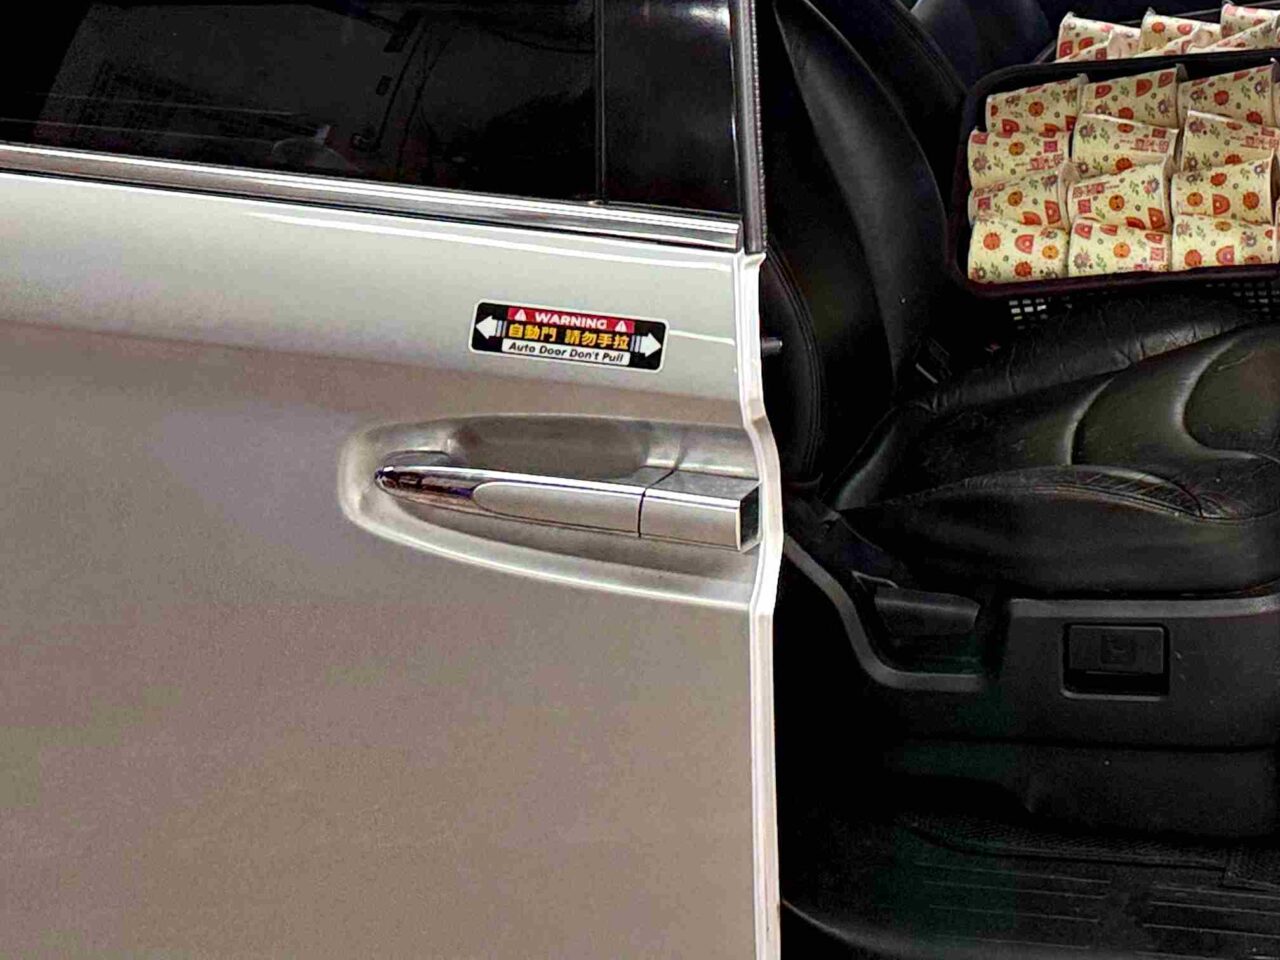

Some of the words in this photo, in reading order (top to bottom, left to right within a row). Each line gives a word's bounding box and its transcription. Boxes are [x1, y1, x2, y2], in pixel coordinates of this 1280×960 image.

[535, 311, 608, 330] WARNING
[508, 323, 557, 342] 自動門
[564, 329, 629, 350] 請勿手拉
[509, 342, 536, 354] Auto
[539, 345, 566, 357] Door
[569, 348, 599, 360] Don't
[602, 351, 624, 362] Pull
